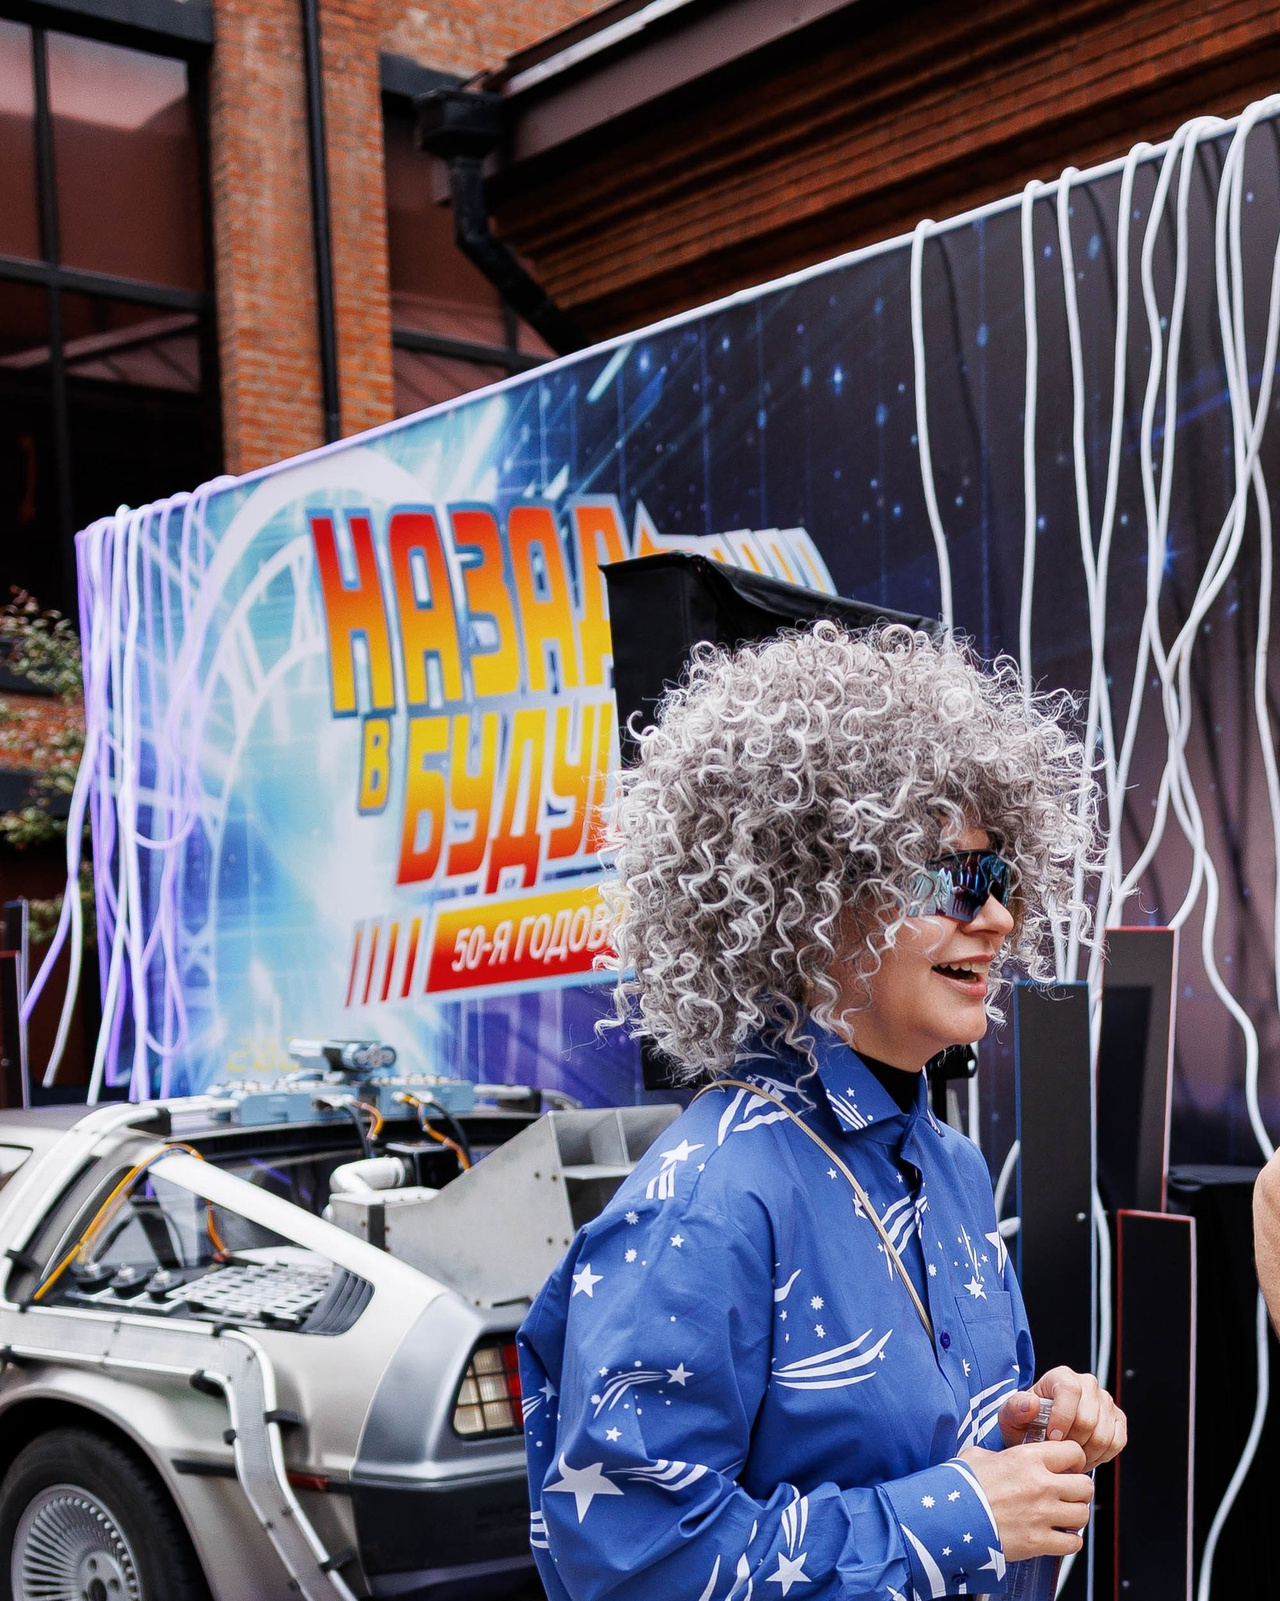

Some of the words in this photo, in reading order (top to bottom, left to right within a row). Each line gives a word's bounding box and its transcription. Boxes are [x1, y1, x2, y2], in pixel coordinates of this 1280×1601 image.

[359, 717, 392, 810] В
[450, 919, 513, 972] 50-Я
[513, 904, 618, 965] ГОДОВ
